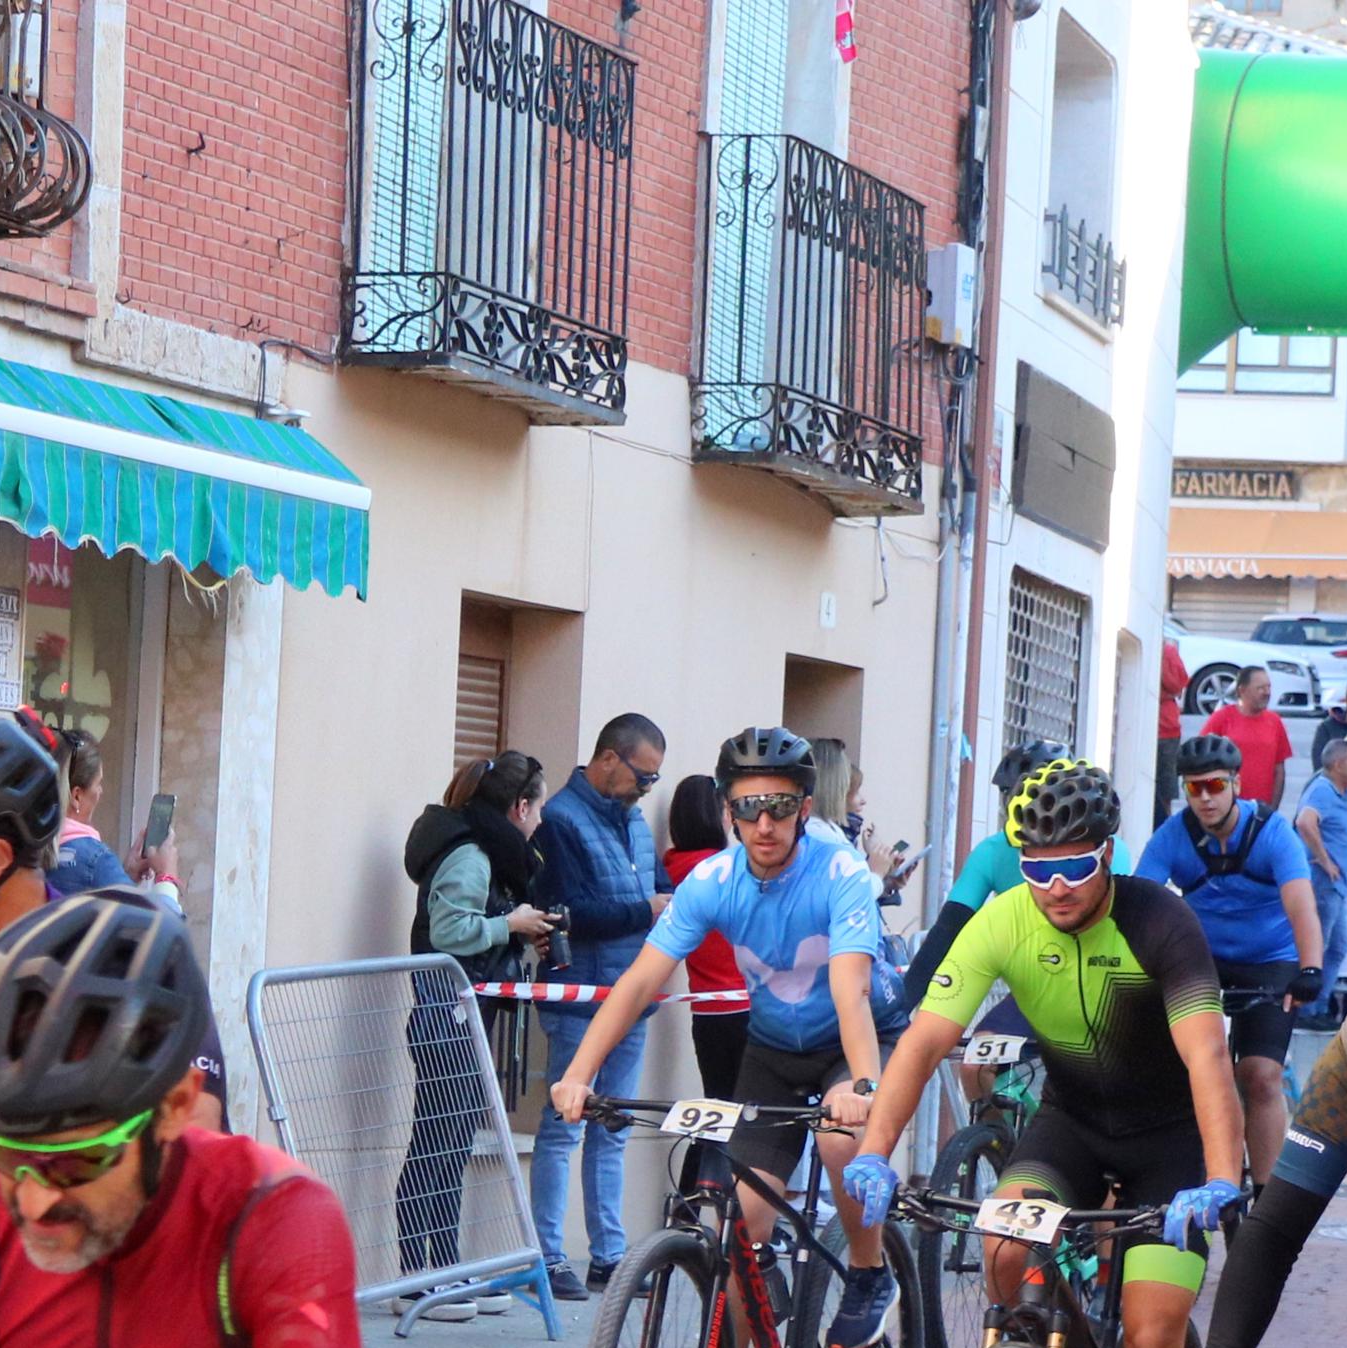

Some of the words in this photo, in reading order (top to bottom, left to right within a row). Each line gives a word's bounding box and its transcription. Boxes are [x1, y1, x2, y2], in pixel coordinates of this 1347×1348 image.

[1174, 472, 1293, 497] FARMACIA
[976, 1040, 1008, 1057] 51
[678, 1107, 724, 1133] 92
[994, 1200, 1047, 1230] 43
